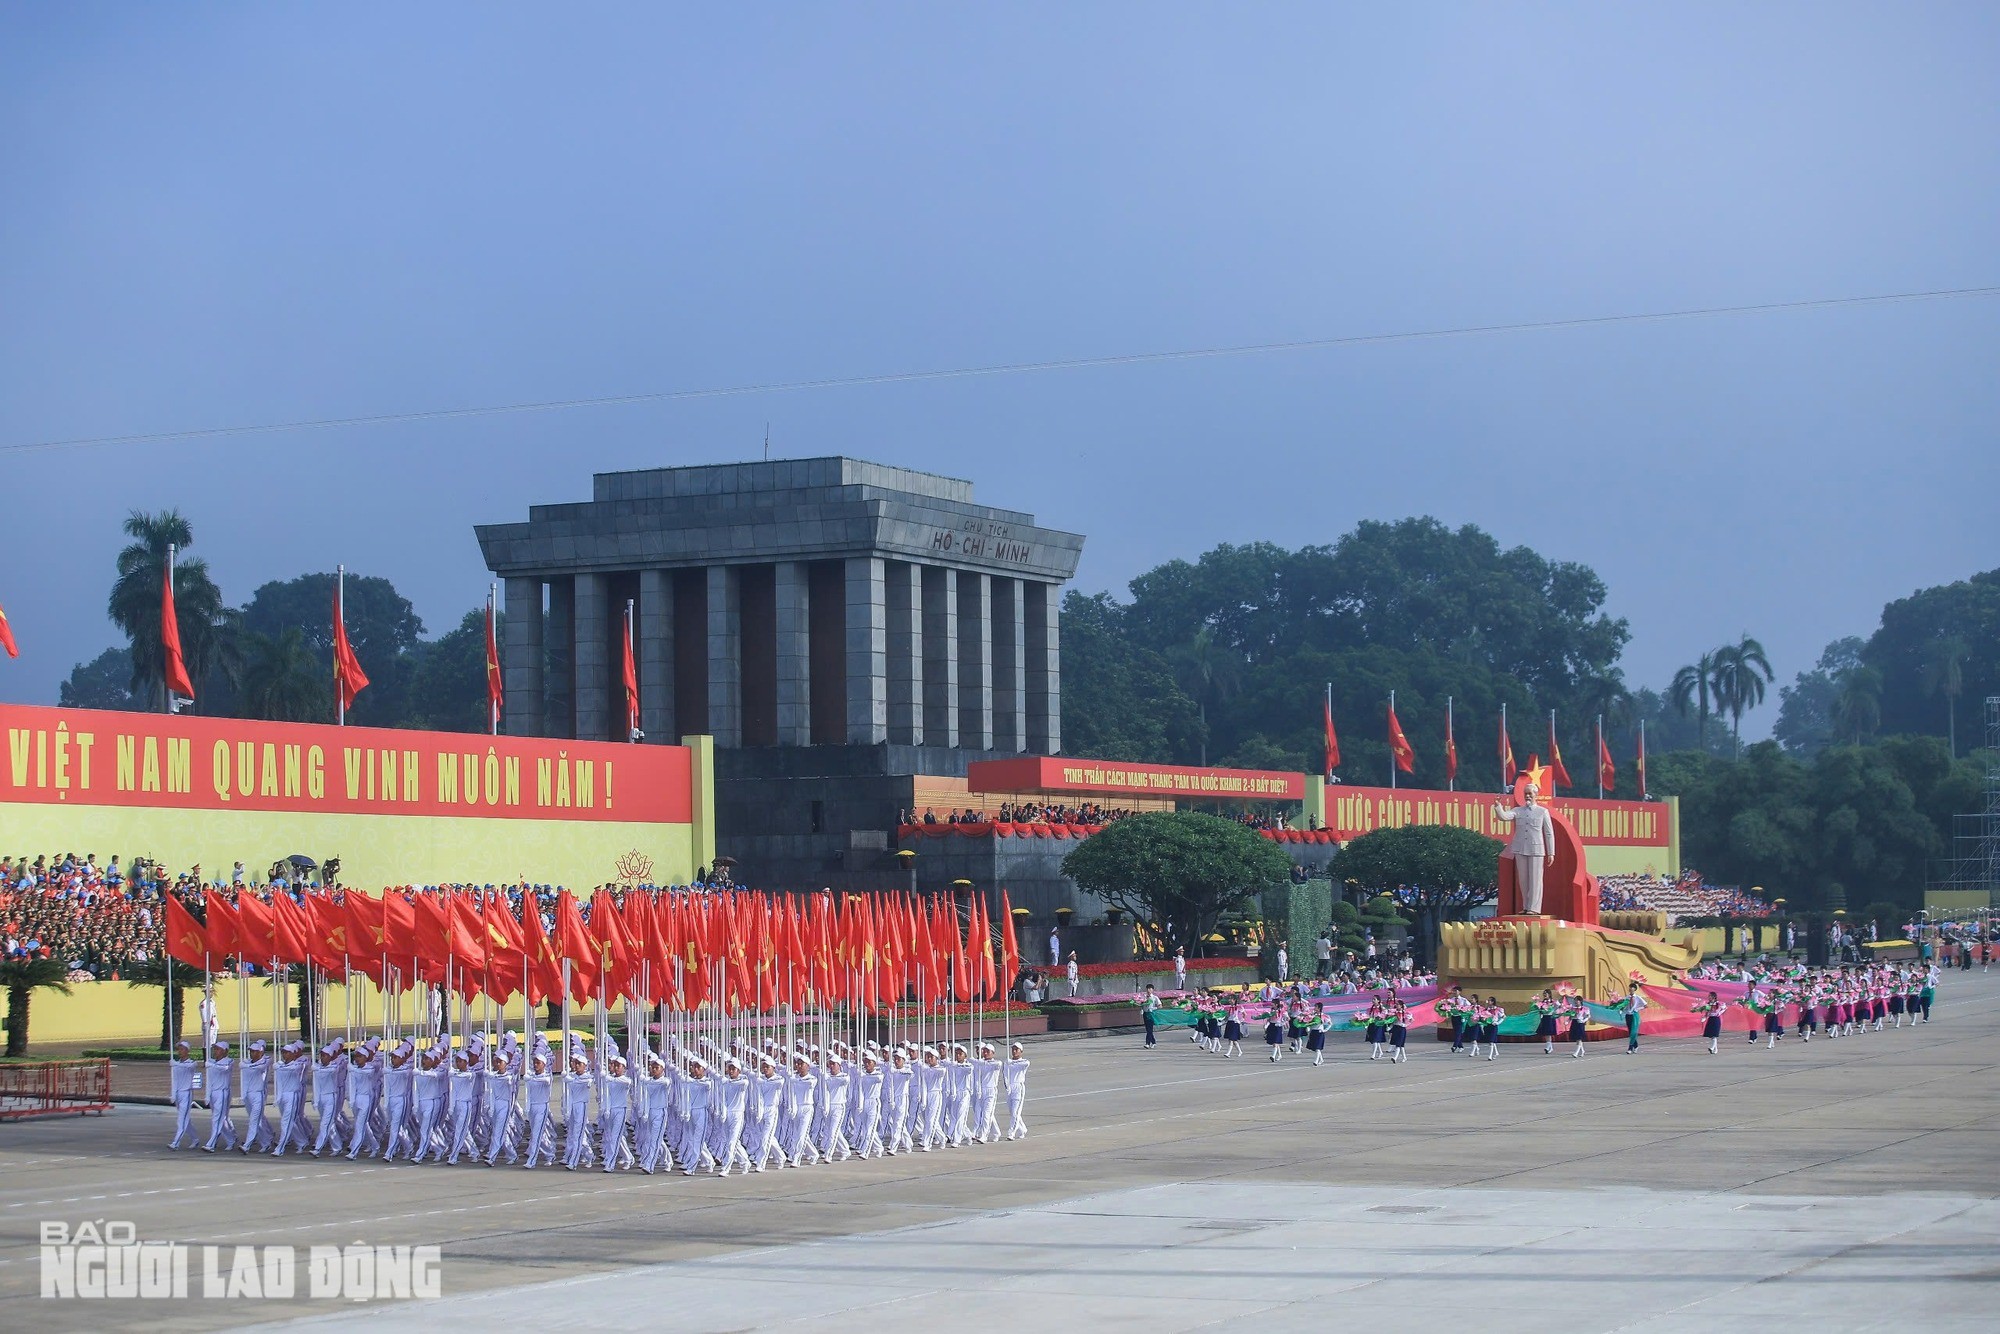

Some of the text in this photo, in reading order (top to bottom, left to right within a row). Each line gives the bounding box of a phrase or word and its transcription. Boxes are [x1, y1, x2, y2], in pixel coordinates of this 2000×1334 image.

[9, 720, 94, 800] VIỆT
[117, 734, 191, 793] NAM
[213, 739, 325, 801] QUANG
[343, 747, 419, 802] VINH
[438, 746, 520, 806] MUÔN
[1064, 768, 1083, 783] TINH
[1107, 768, 1126, 786] CÁCH
[1127, 771, 1148, 789] MẠNG
[1149, 771, 1173, 788] THÁNG
[1174, 772, 1189, 789] TÁM
[1190, 773, 1200, 790] VÀ
[1201, 772, 1218, 791] QUỐC
[1220, 775, 1242, 791] KHÁNH
[1337, 793, 1372, 832] NƯỚC
[1417, 796, 1440, 827] HÒA
[1578, 808, 1599, 838] NAM
[1602, 805, 1629, 839] MUÔN
